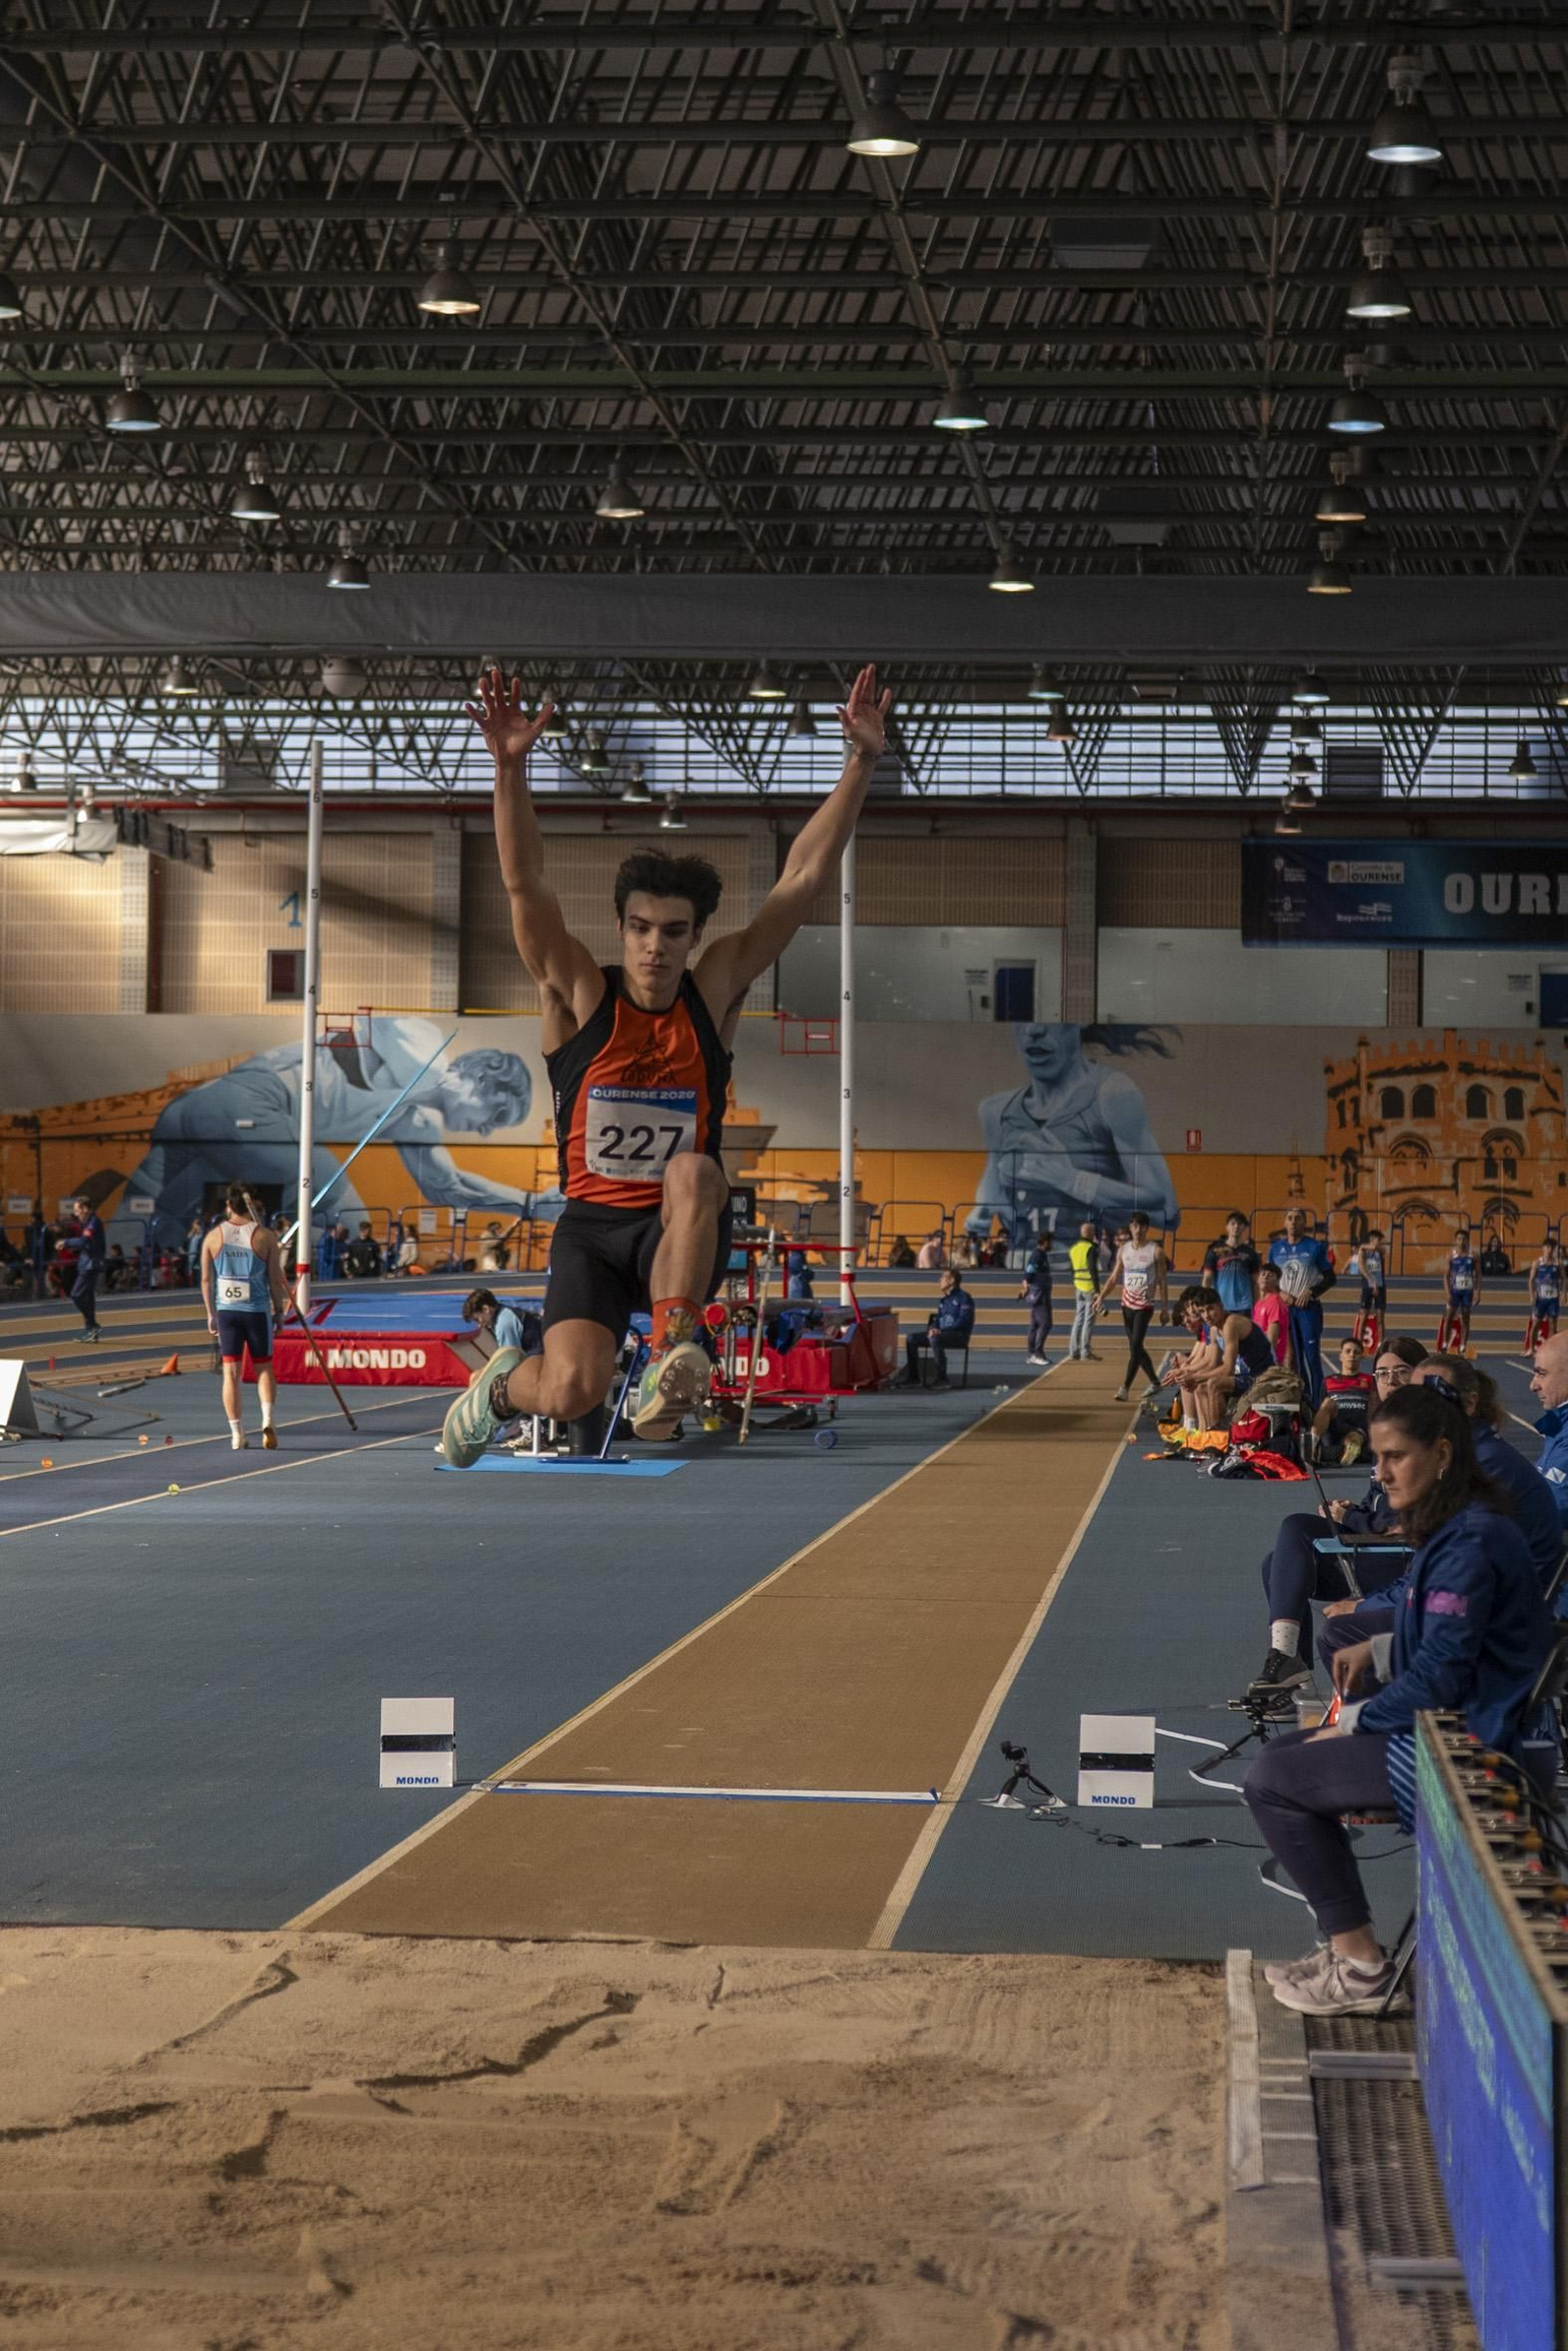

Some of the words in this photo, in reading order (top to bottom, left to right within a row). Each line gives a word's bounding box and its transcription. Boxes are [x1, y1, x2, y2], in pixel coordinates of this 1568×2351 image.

[1351, 872, 1401, 882] OURENSE
[311, 888, 318, 900] 5
[844, 893, 851, 904] 5
[308, 985, 316, 996] 4
[844, 991, 851, 1002] 4
[306, 1081, 313, 1092] 3
[592, 1088, 659, 1100] OURENSE
[843, 1089, 851, 1100] 3
[599, 1125, 684, 1162] 227
[303, 1178, 311, 1189] 2
[843, 1186, 851, 1197] 2
[1027, 1207, 1058, 1232] 17
[1128, 1276, 1145, 1287] 277
[224, 1287, 242, 1298] 65
[1362, 1326, 1374, 1348] 3
[327, 1348, 426, 1369] MONDO
[1091, 1795, 1136, 1805] MONDO
